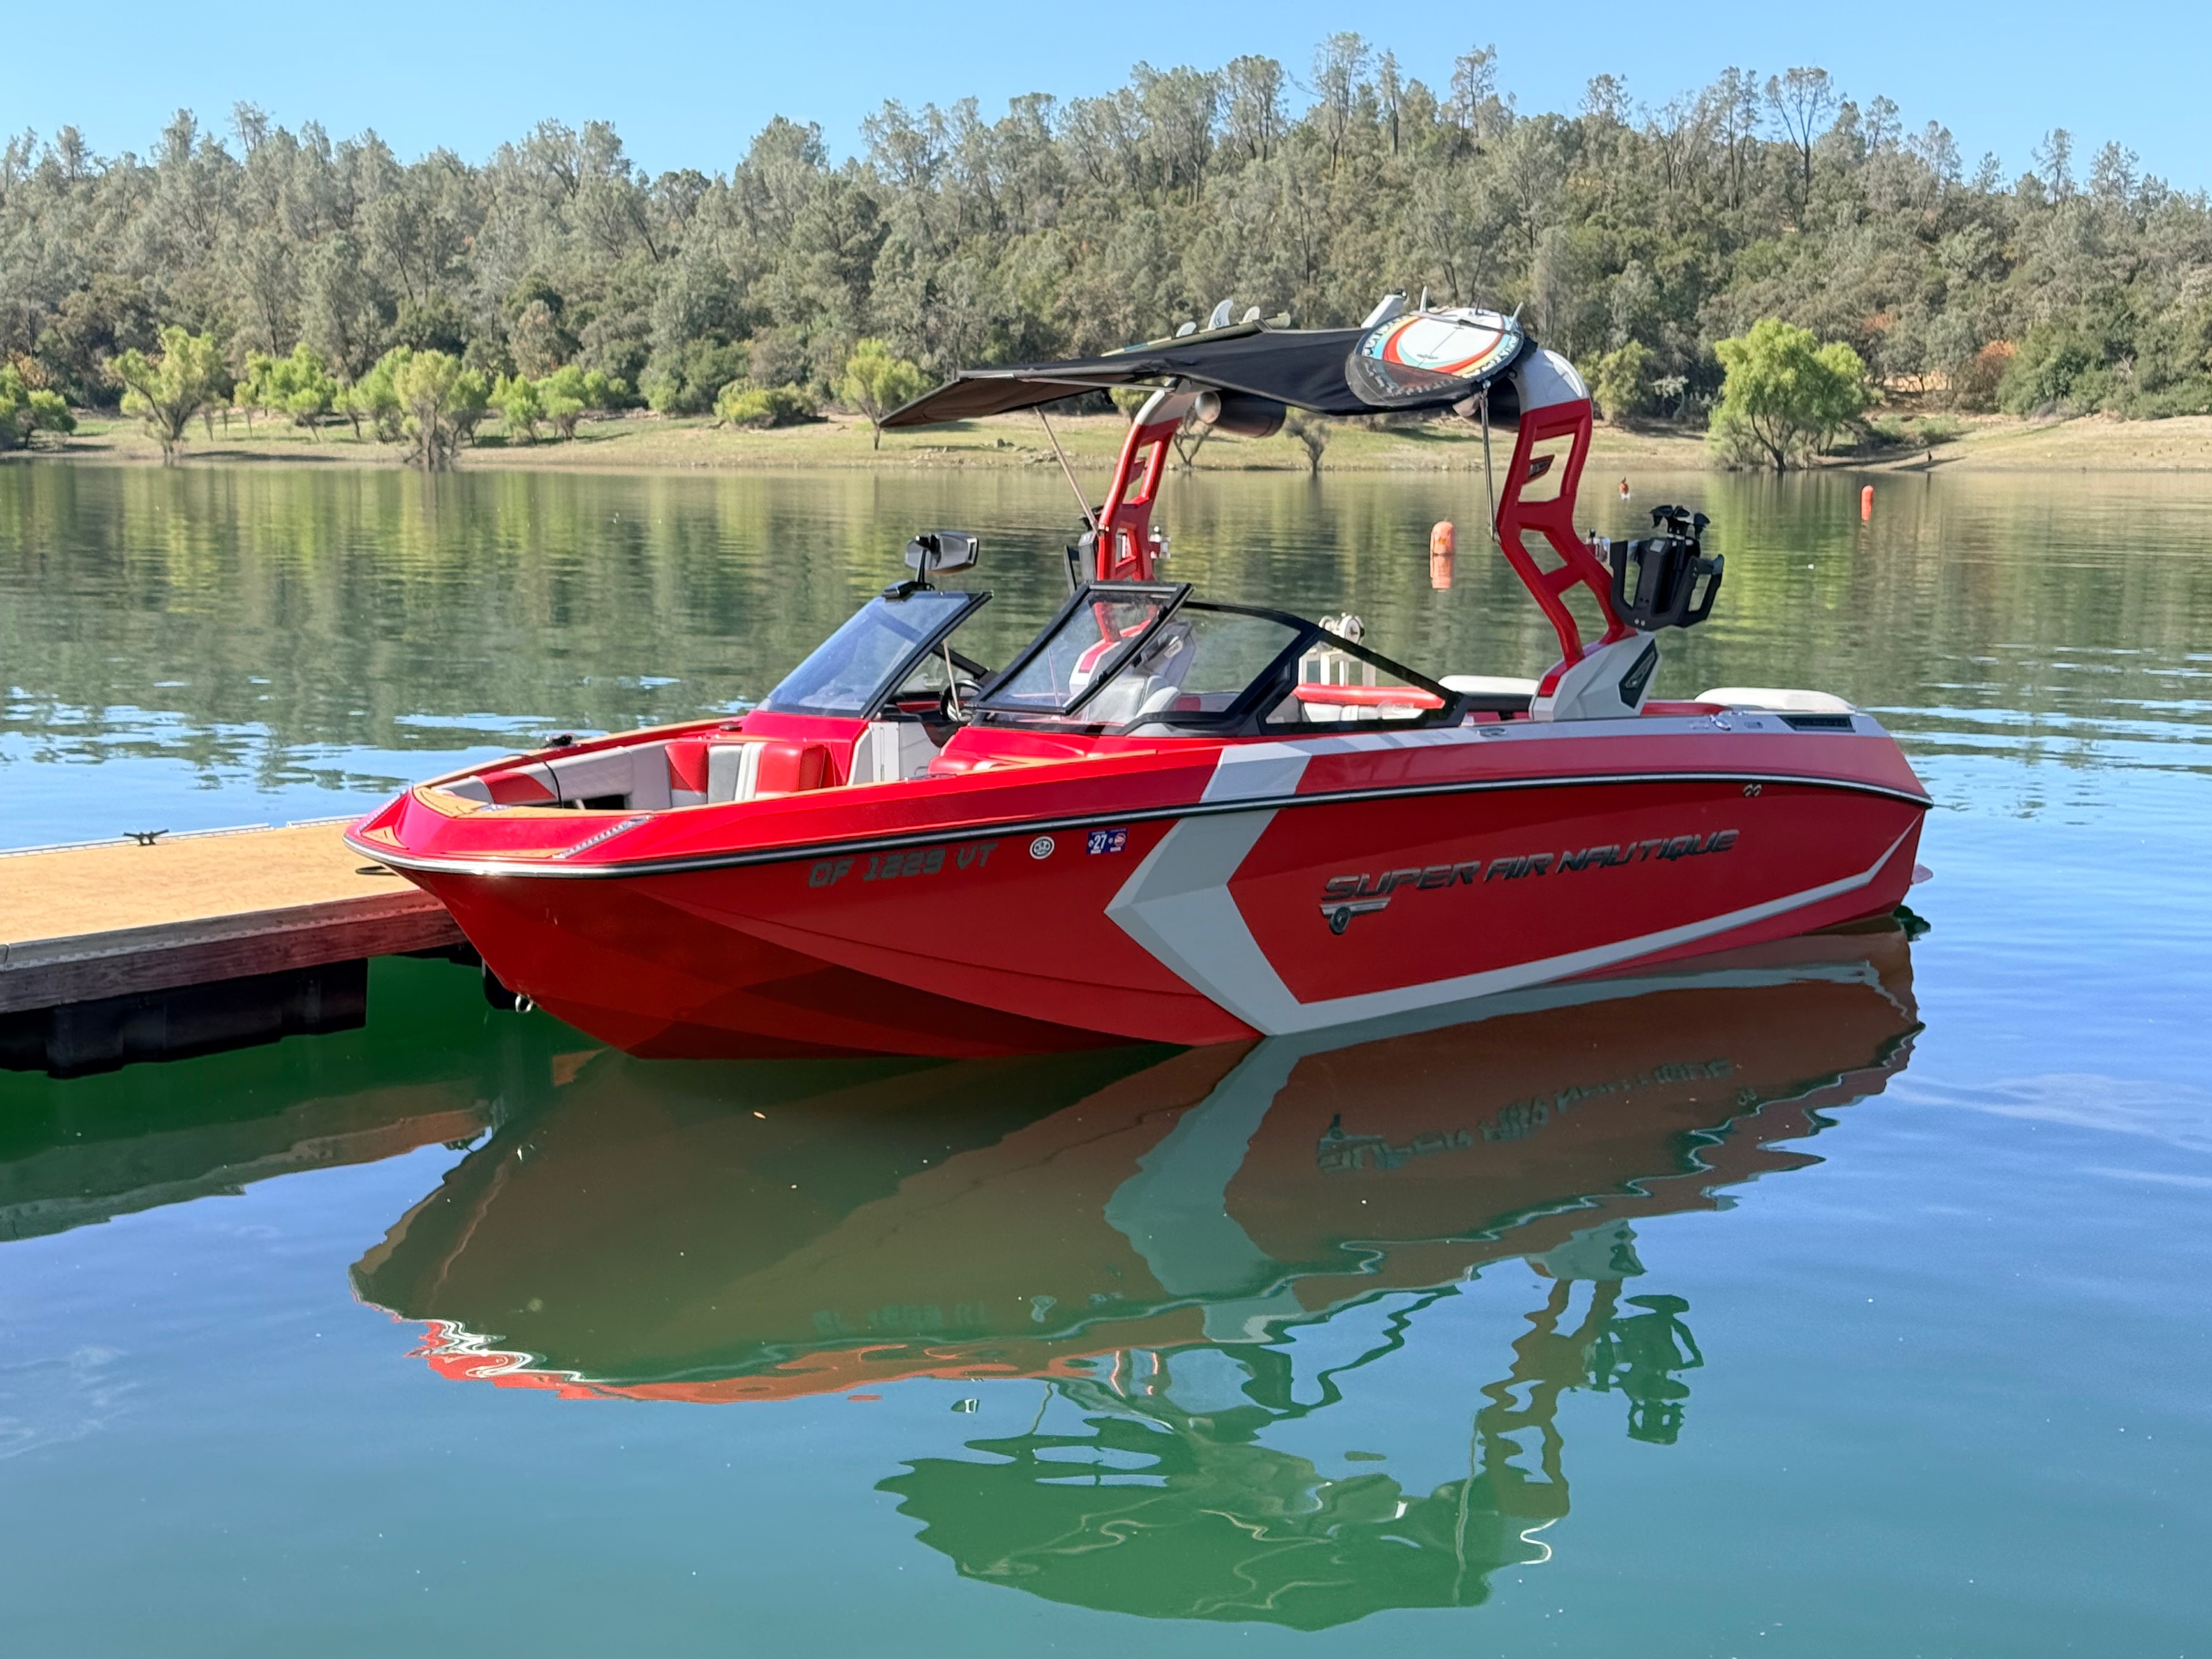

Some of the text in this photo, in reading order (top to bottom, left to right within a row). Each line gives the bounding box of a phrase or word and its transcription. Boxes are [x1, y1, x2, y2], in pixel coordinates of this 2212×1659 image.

[1094, 834, 1107, 850] 27
[1321, 829, 1740, 900] SUPER AIR NAUTIQUE
